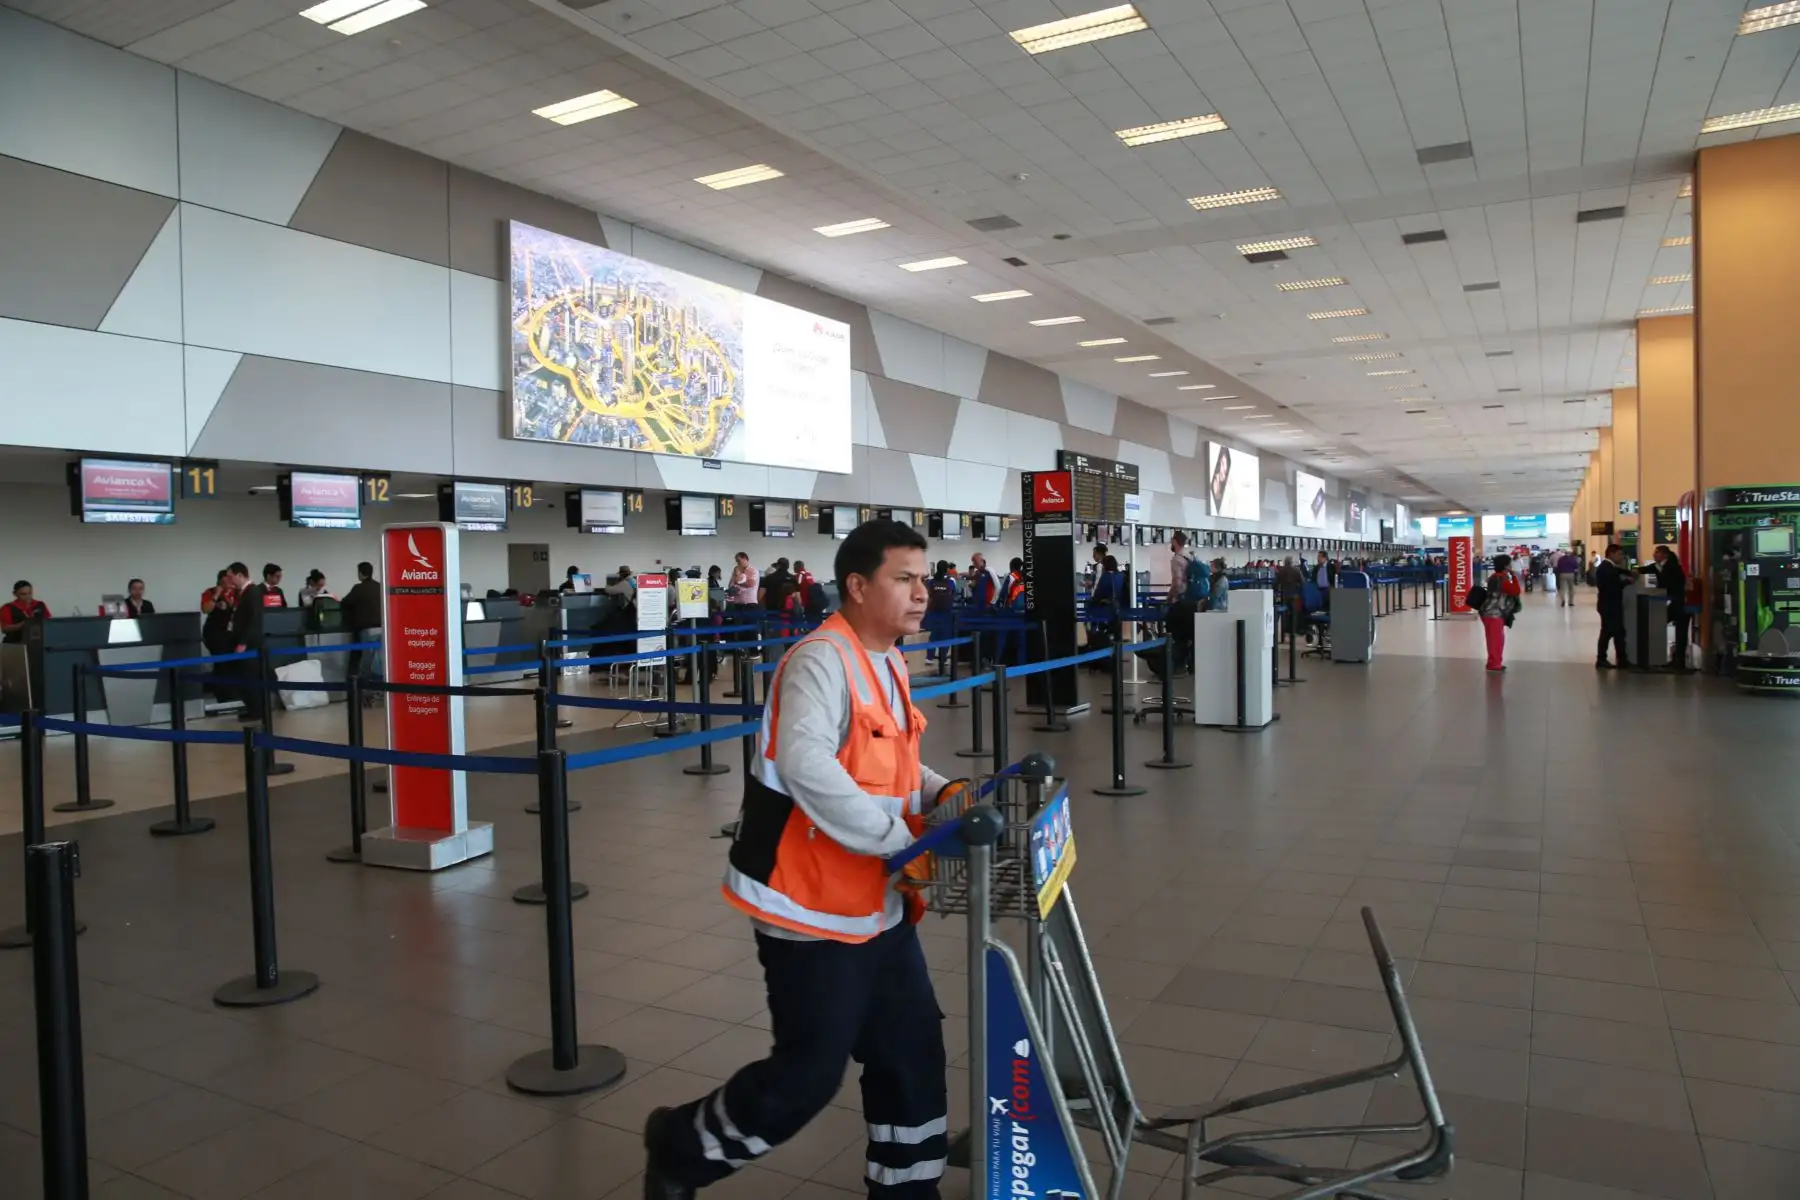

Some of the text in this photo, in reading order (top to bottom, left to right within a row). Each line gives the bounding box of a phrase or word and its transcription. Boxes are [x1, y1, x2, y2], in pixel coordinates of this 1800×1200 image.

[92, 475, 146, 486] Avianca
[188, 467, 215, 494] 11
[367, 478, 389, 501] 12
[514, 486, 533, 508] 13
[627, 493, 644, 513] 14
[721, 498, 734, 516] 15
[797, 504, 809, 520] 16
[1024, 523, 1034, 578] ALLIANCE
[401, 569, 439, 580] Avianca
[1455, 541, 1466, 593] PERUVIAN
[1026, 581, 1035, 610] STAR
[404, 627, 438, 637] Entrega de
[407, 639, 435, 648] equipaje
[408, 661, 436, 671] Baggage
[410, 672, 435, 680] drop off
[406, 695, 440, 704] Entrega de
[408, 705, 438, 715] bagagem
[992, 1140, 1001, 1149] TU
[992, 1150, 1001, 1169] PARA
[993, 1170, 1001, 1197] PRECIO
